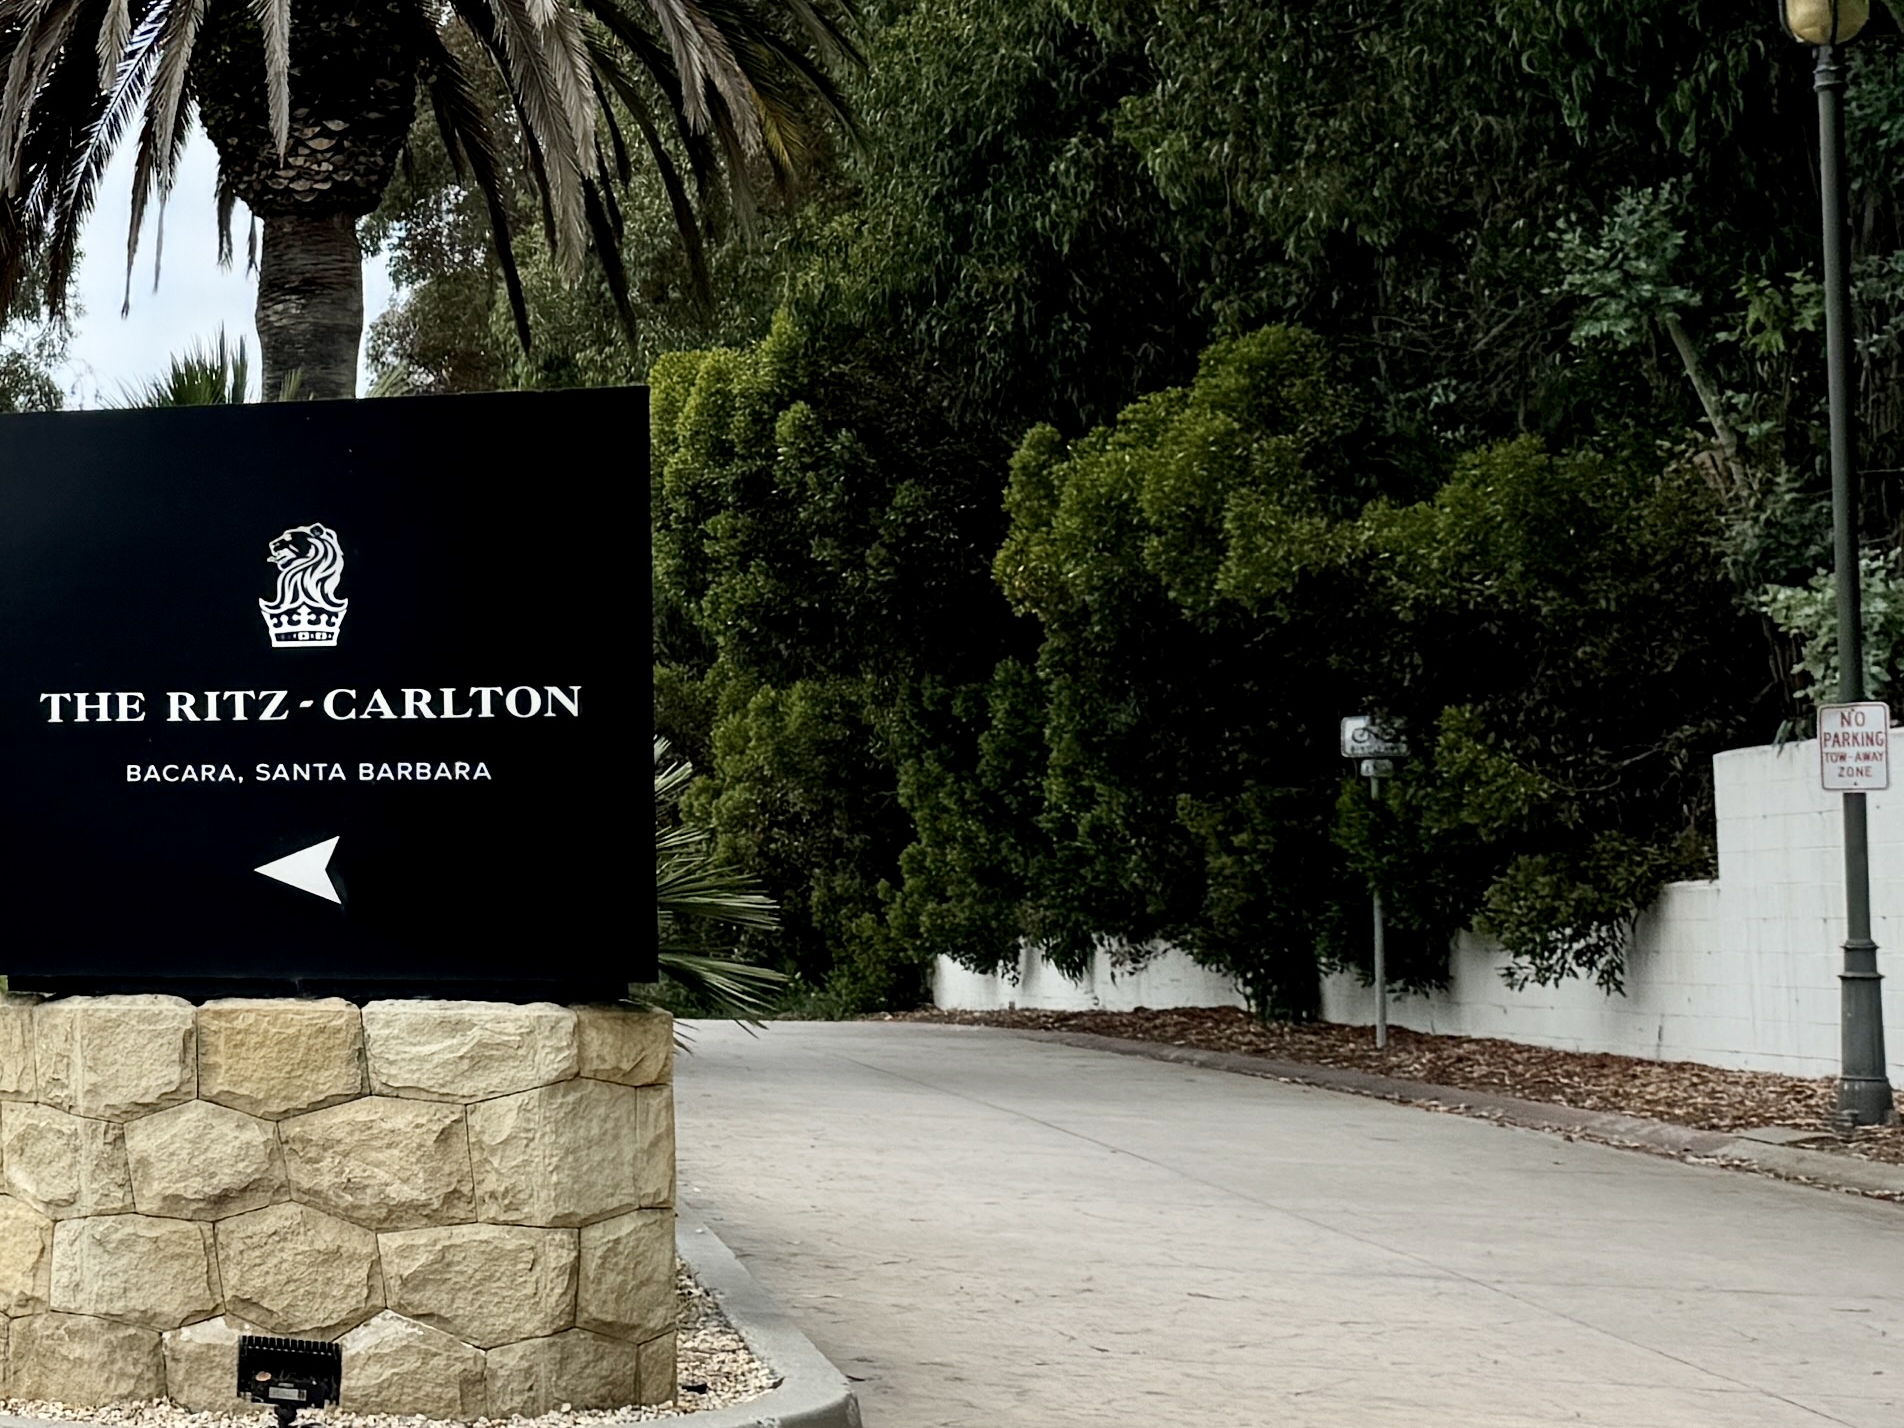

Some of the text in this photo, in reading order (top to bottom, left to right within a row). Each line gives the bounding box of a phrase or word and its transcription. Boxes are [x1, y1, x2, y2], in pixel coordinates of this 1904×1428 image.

[39, 684, 583, 724] THE RITZ-CARLTON
[1840, 711, 1866, 727] NO
[1823, 730, 1884, 748] PARKING
[1824, 751, 1884, 764] TOW-AWAY
[125, 760, 493, 784] BACARA, SANTA BARBARA
[1837, 765, 1873, 778] ZONE
